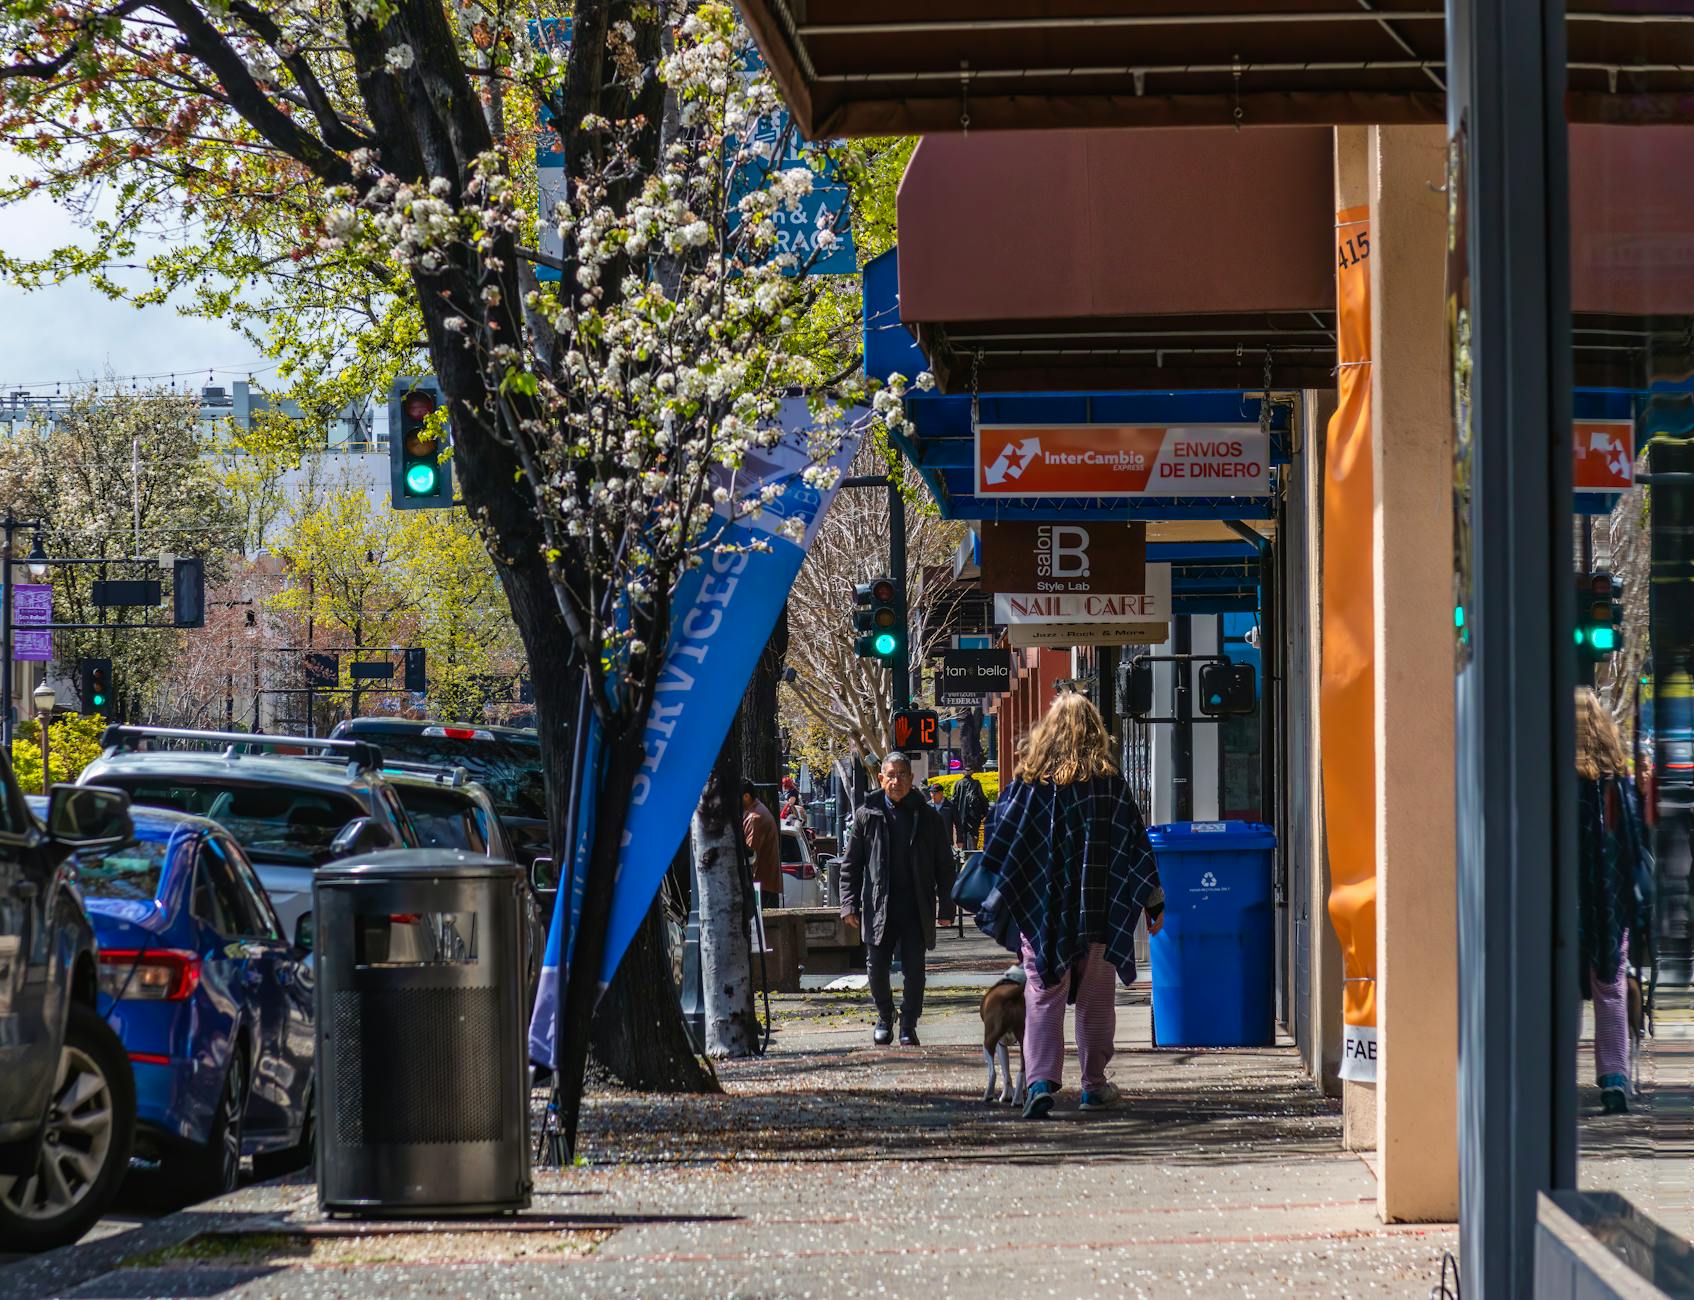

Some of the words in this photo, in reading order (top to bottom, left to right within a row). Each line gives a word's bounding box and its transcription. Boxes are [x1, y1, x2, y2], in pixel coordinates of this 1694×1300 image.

[790, 202, 808, 224] &
[1044, 450, 1145, 466] InterCambio
[1173, 441, 1243, 458] ENVIOS
[1112, 464, 1145, 472] EXPRESS
[1159, 462, 1186, 478] DE
[1189, 462, 1262, 479] DINERO
[1033, 525, 1051, 577] salon
[1037, 581, 1065, 593] Style
[1068, 581, 1090, 591] Lab
[1010, 595, 1073, 617] NAIL
[1084, 595, 1155, 617] CARE
[945, 665, 967, 677] tan
[977, 664, 1008, 677] bella
[946, 697, 981, 705] FEDERAL
[920, 718, 936, 744] 12
